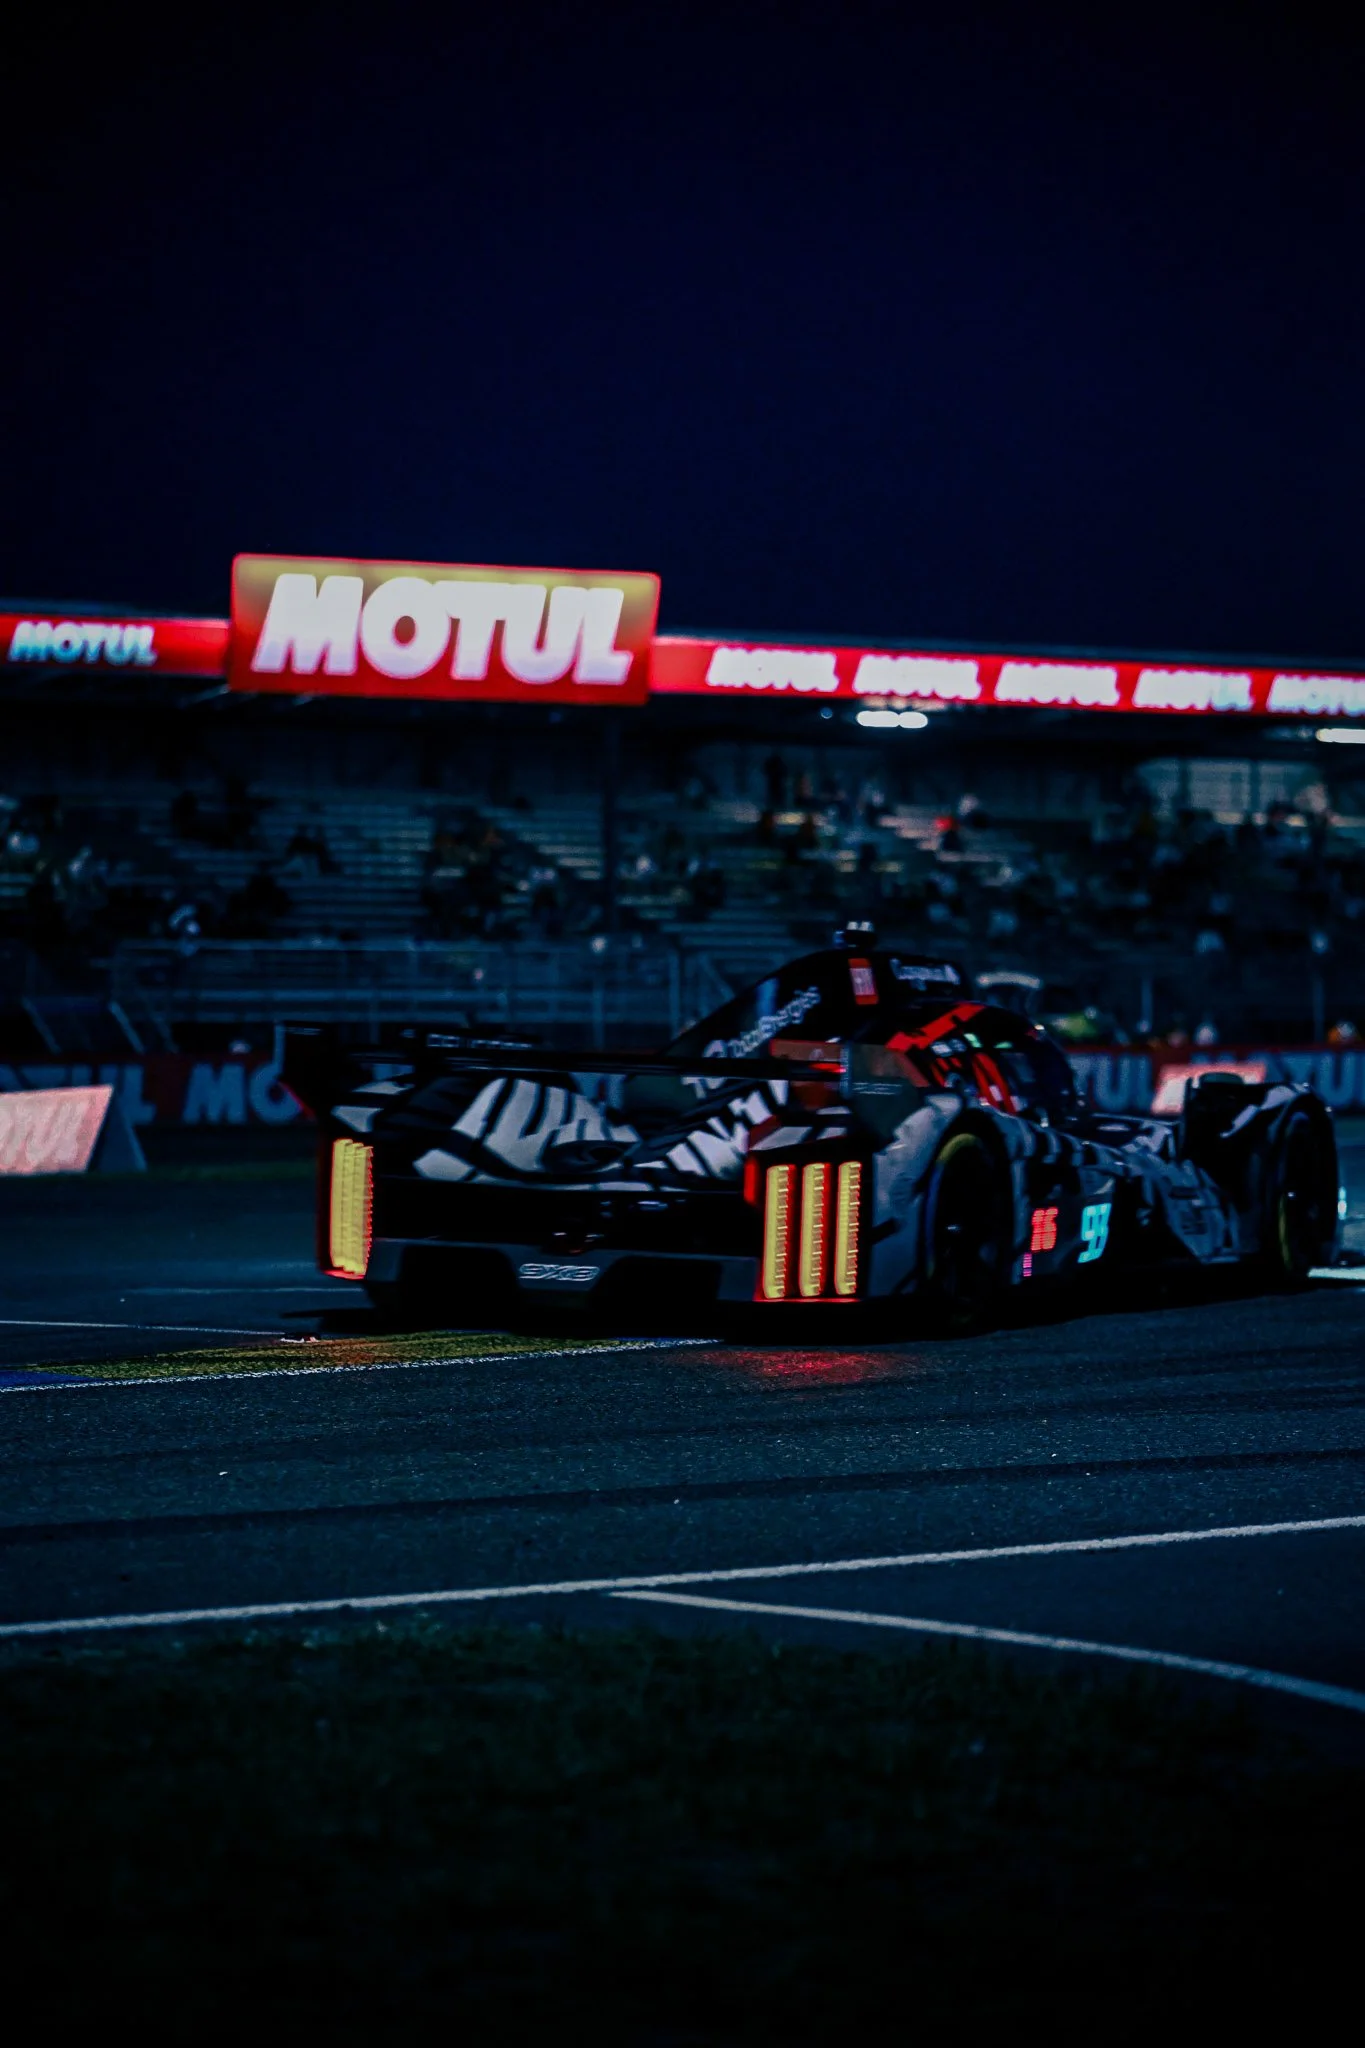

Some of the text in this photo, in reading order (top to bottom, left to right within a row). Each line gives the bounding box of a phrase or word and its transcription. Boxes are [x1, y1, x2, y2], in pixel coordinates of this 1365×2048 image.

[7, 620, 158, 666] MOTUL
[250, 573, 634, 685] MOTUL
[1077, 1203, 1112, 1263] 93
